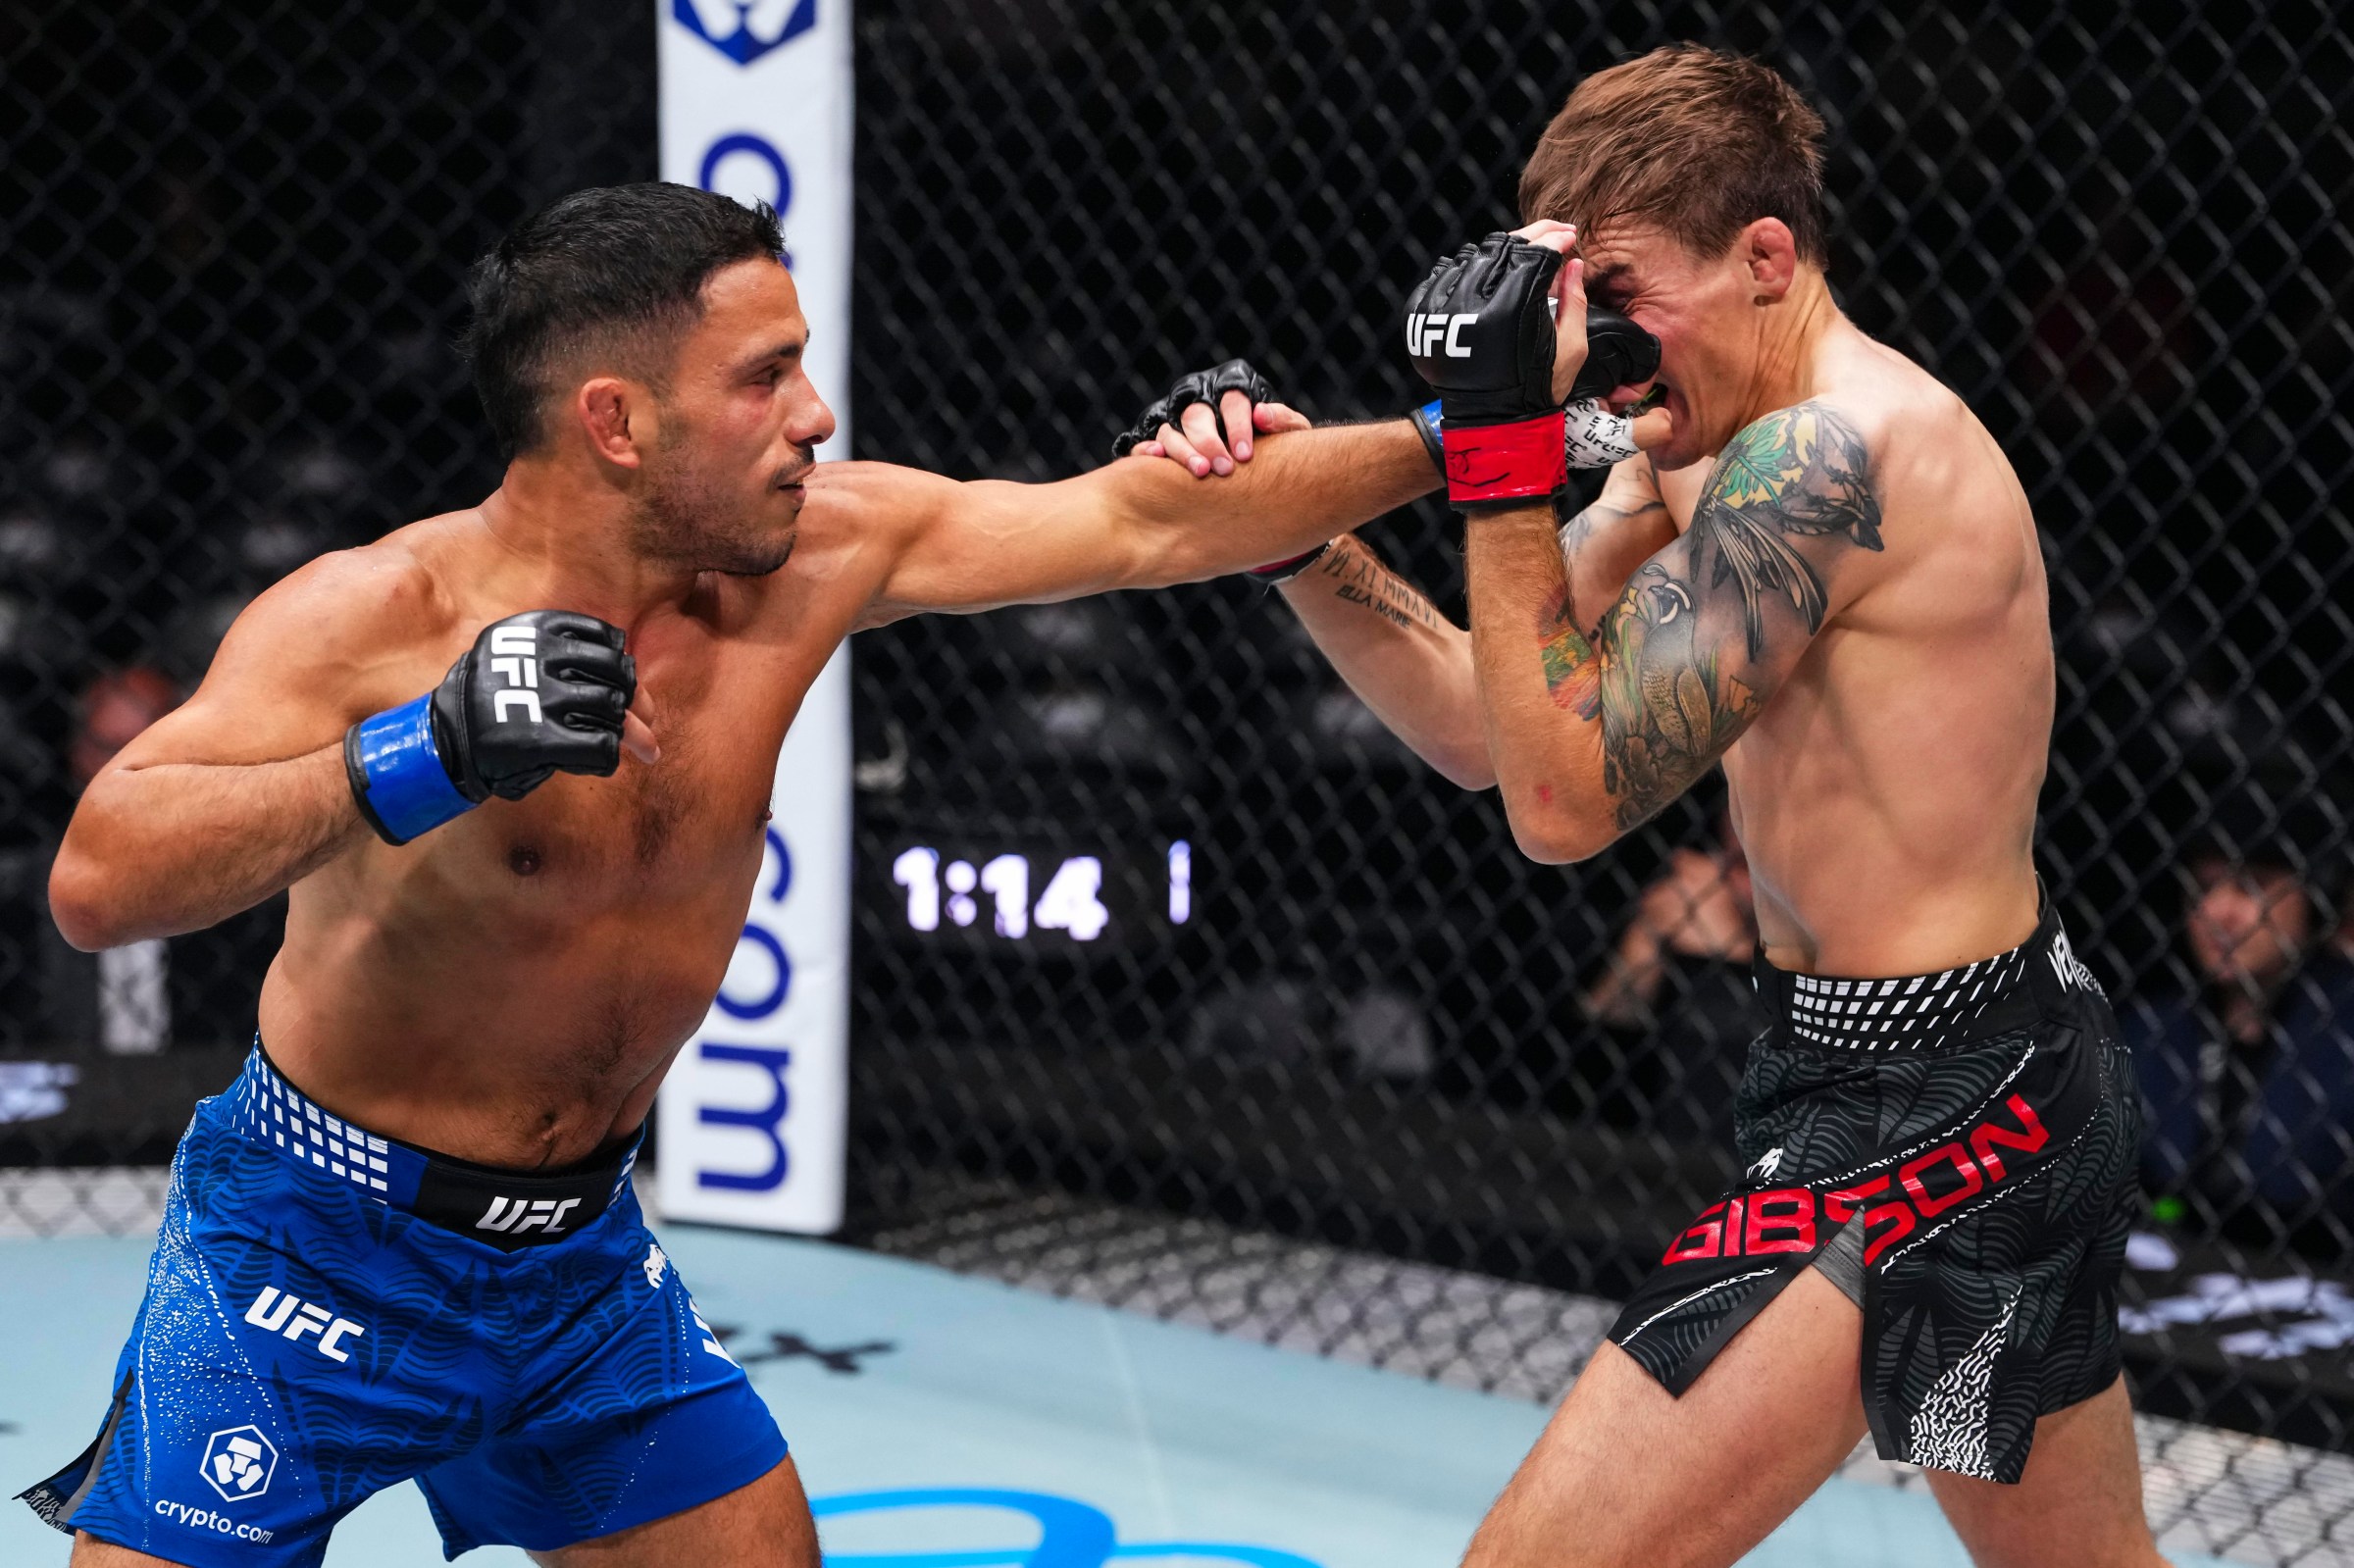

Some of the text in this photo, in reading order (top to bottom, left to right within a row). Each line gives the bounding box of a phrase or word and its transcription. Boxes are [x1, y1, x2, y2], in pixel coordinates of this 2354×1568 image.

[1407, 313, 1479, 358] UFC
[1335, 584, 1411, 629] ELLA MARIE
[490, 626, 542, 723] UFC
[893, 845, 1109, 941] 1:14
[1662, 1092, 2051, 1267] GIBSON
[475, 1195, 582, 1235] UFC
[244, 1286, 366, 1363] UFC
[155, 1499, 274, 1544] crypto.com
